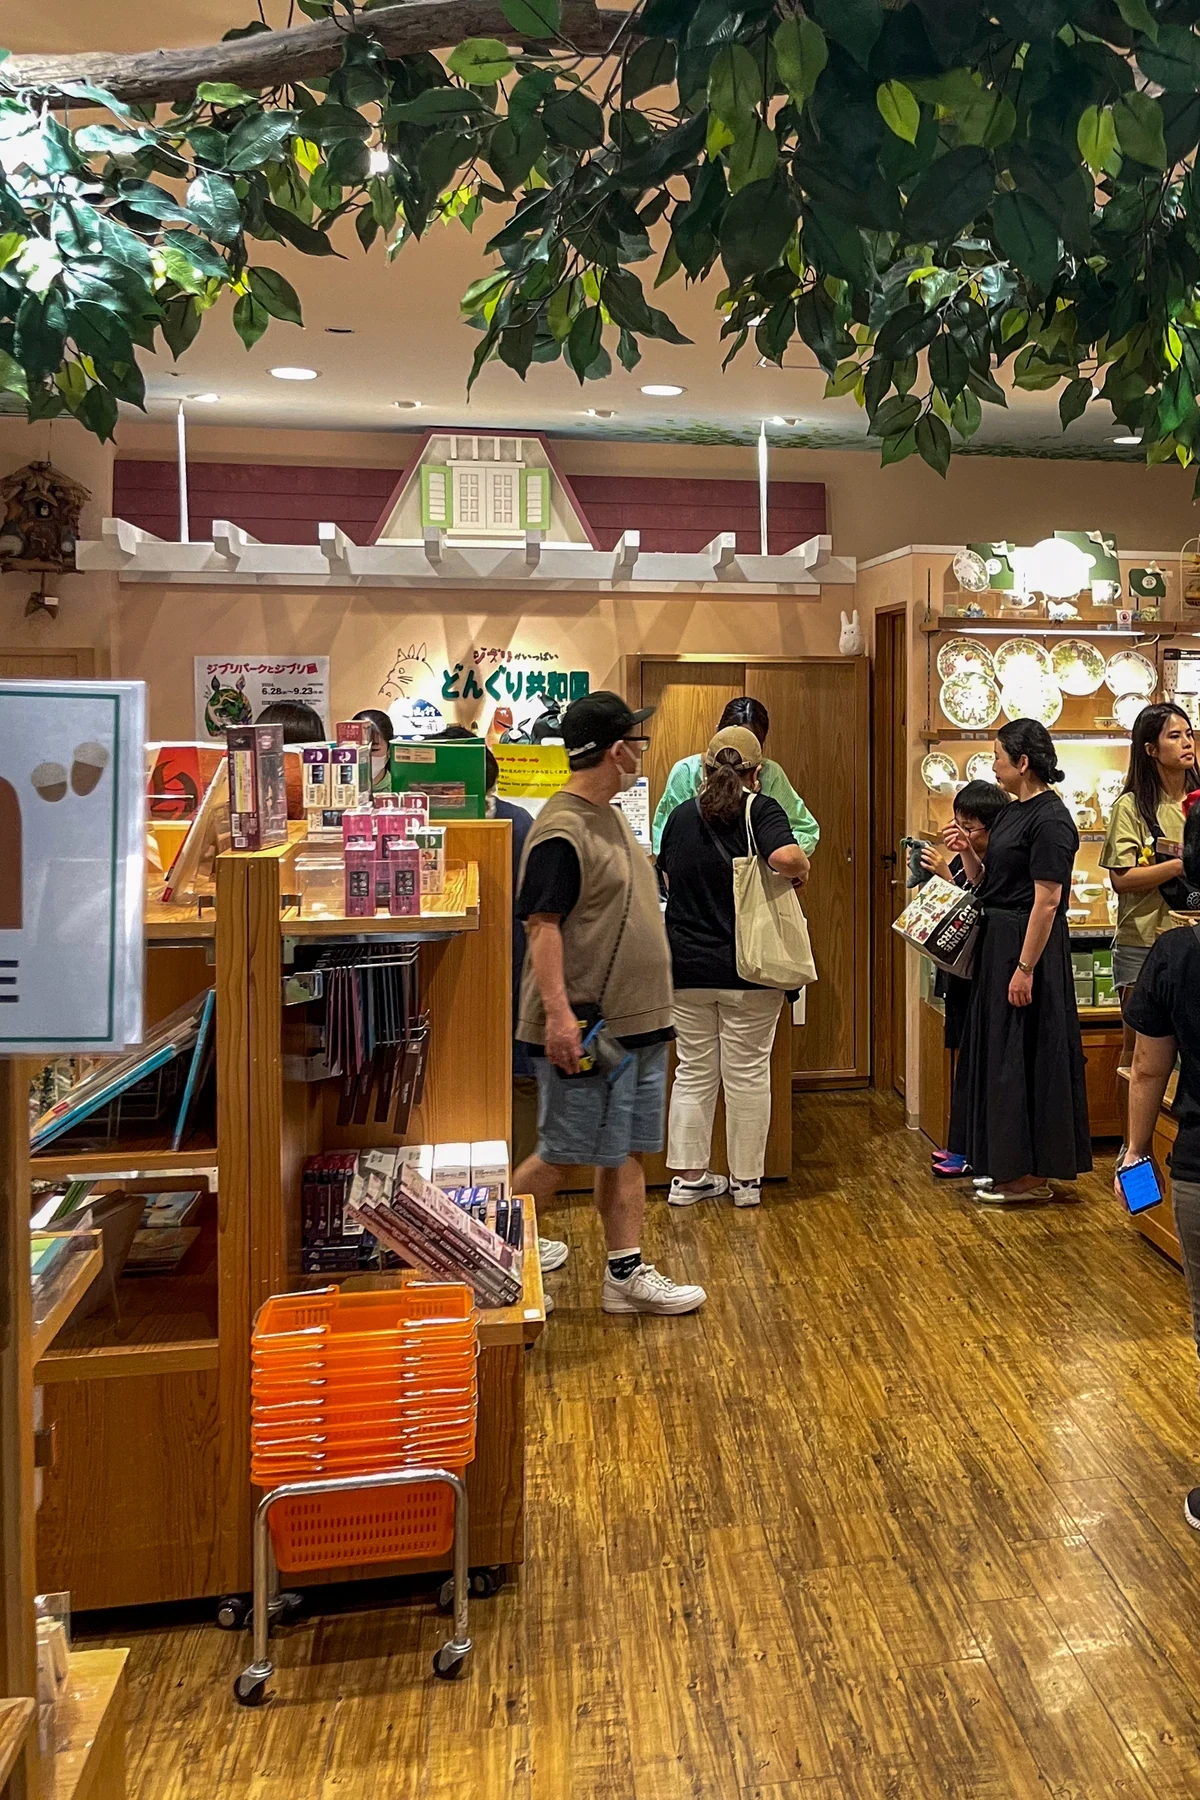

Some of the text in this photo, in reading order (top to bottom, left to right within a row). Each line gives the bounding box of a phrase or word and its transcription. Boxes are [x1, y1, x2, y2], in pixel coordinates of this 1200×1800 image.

[441, 664, 590, 702] どんぐり共和国
